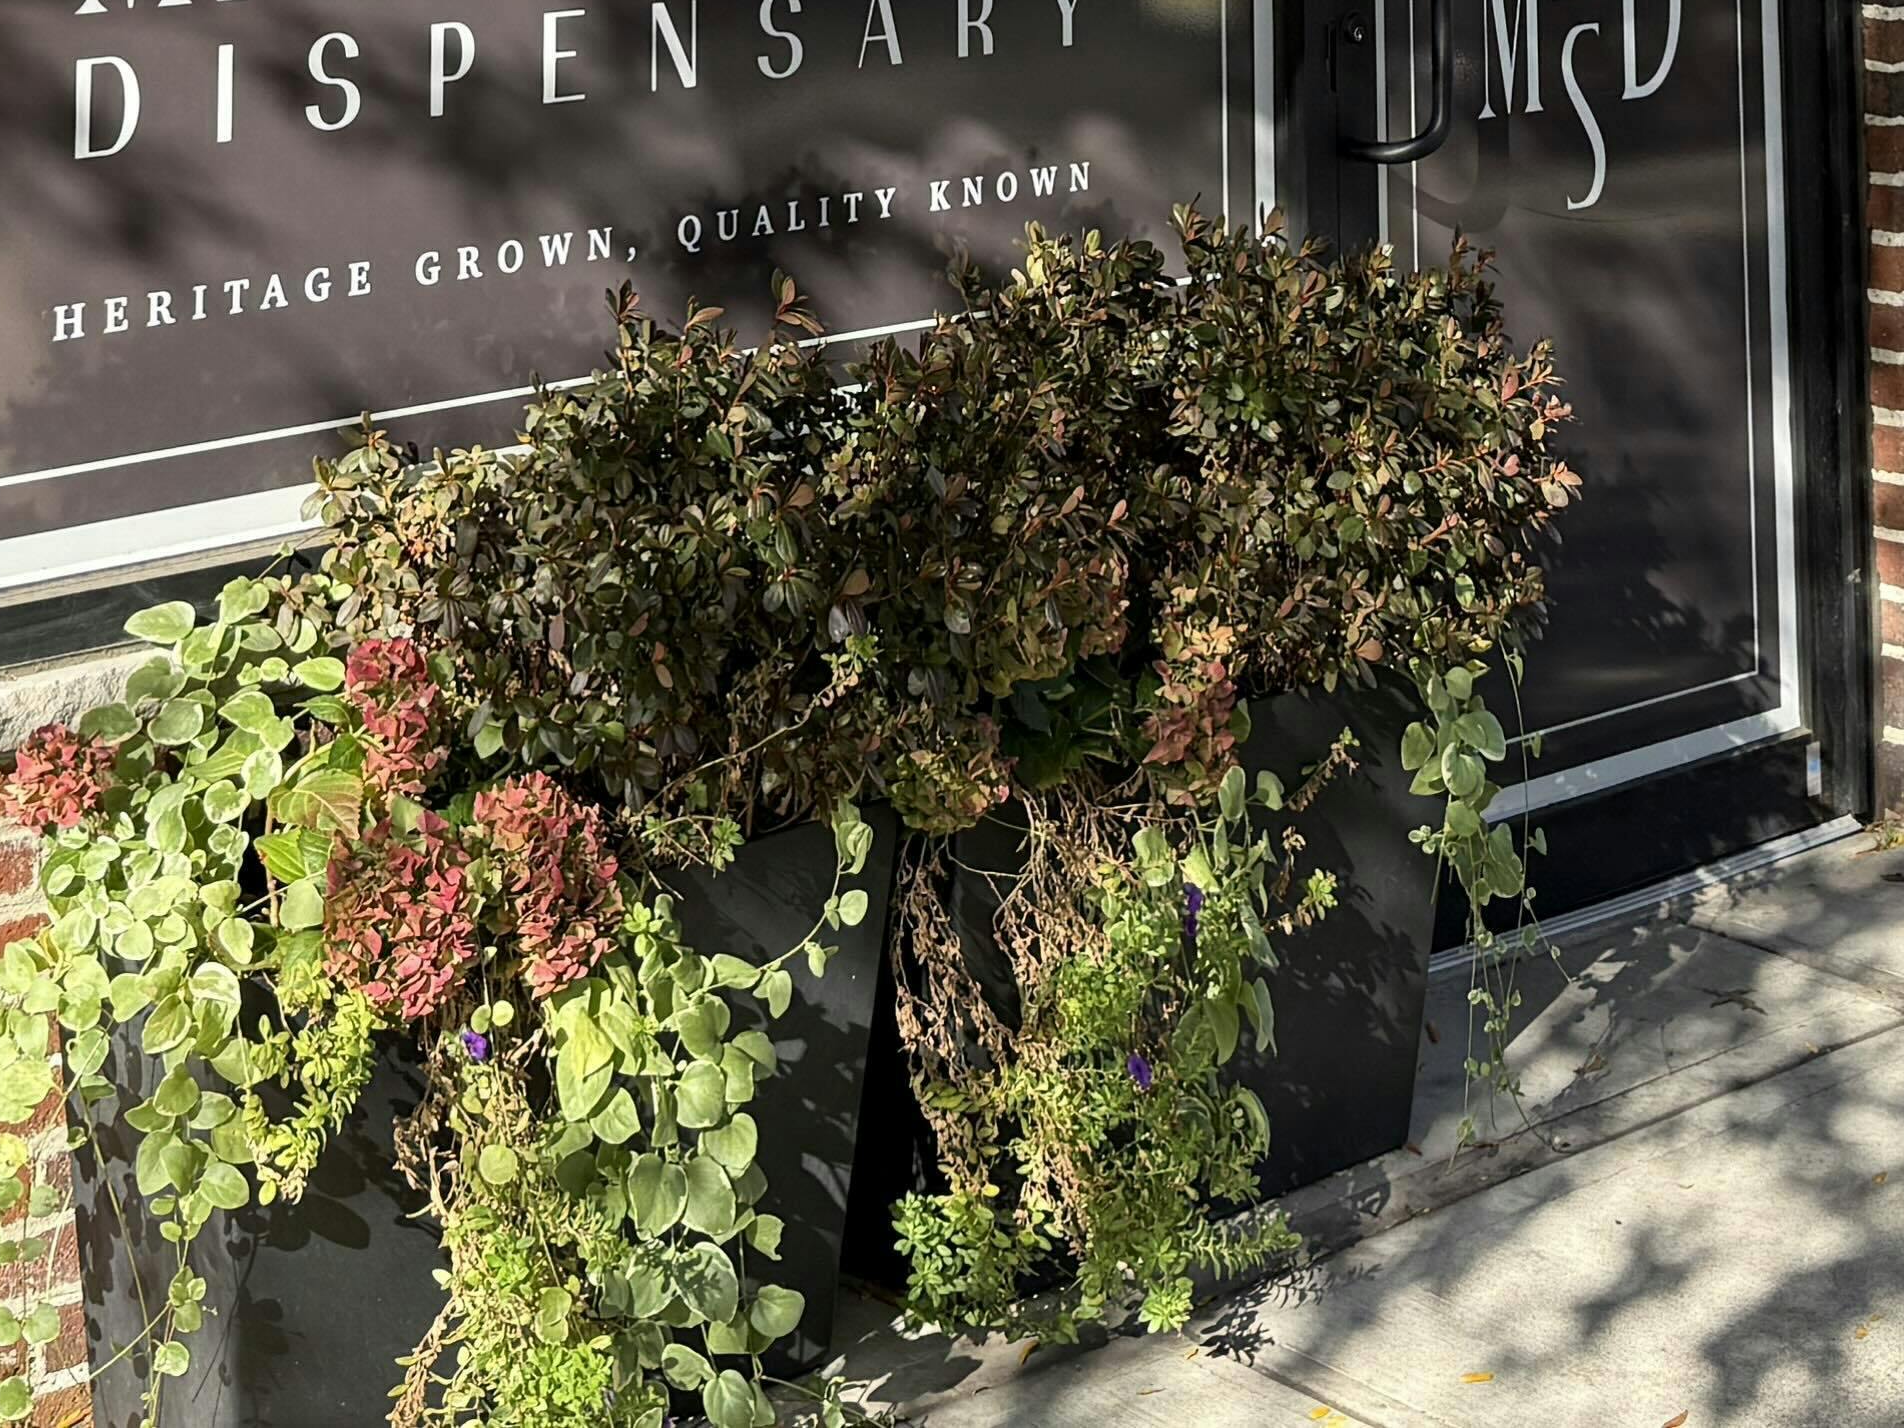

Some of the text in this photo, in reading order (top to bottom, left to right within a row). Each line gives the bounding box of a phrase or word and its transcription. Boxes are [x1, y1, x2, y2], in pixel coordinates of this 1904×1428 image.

[52, 161, 1093, 341] HERITAGE GROWN, QUALITY KNOWN
